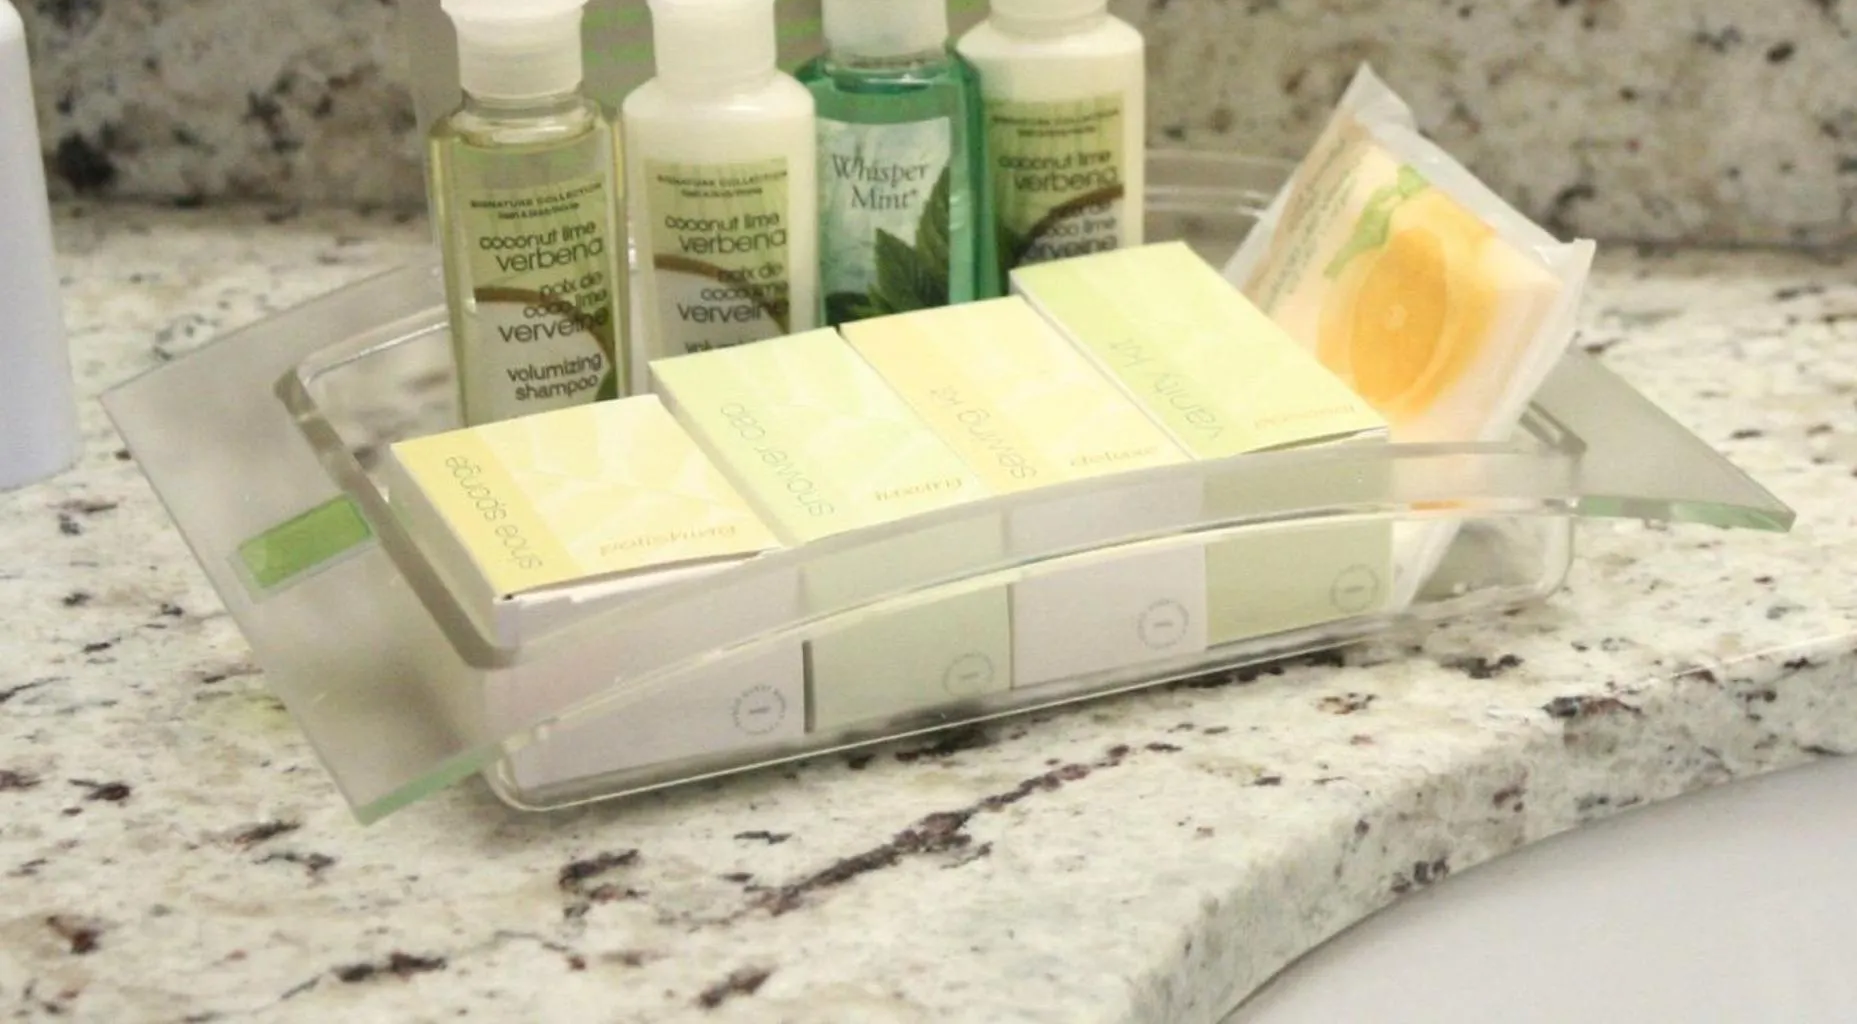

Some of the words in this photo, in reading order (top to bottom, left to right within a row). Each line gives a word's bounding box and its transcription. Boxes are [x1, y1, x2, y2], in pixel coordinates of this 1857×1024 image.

[832, 144, 929, 188] Whisper
[997, 154, 1072, 170] coconut
[1077, 149, 1111, 167] lime
[1014, 164, 1118, 193] verbena
[479, 228, 558, 250] coconut
[561, 221, 597, 242] lime
[664, 214, 739, 233] coconut
[743, 212, 780, 230] lime
[496, 237, 604, 273] verbena
[678, 227, 788, 255] verbena
[498, 307, 610, 343] verveine
[506, 353, 602, 382] volumizing
[515, 374, 599, 401] shampoo
[720, 402, 767, 441] cap
[956, 408, 1038, 479] sewing
[445, 454, 508, 523] sponge
[753, 444, 836, 517] shower
[494, 524, 544, 570] shoe
